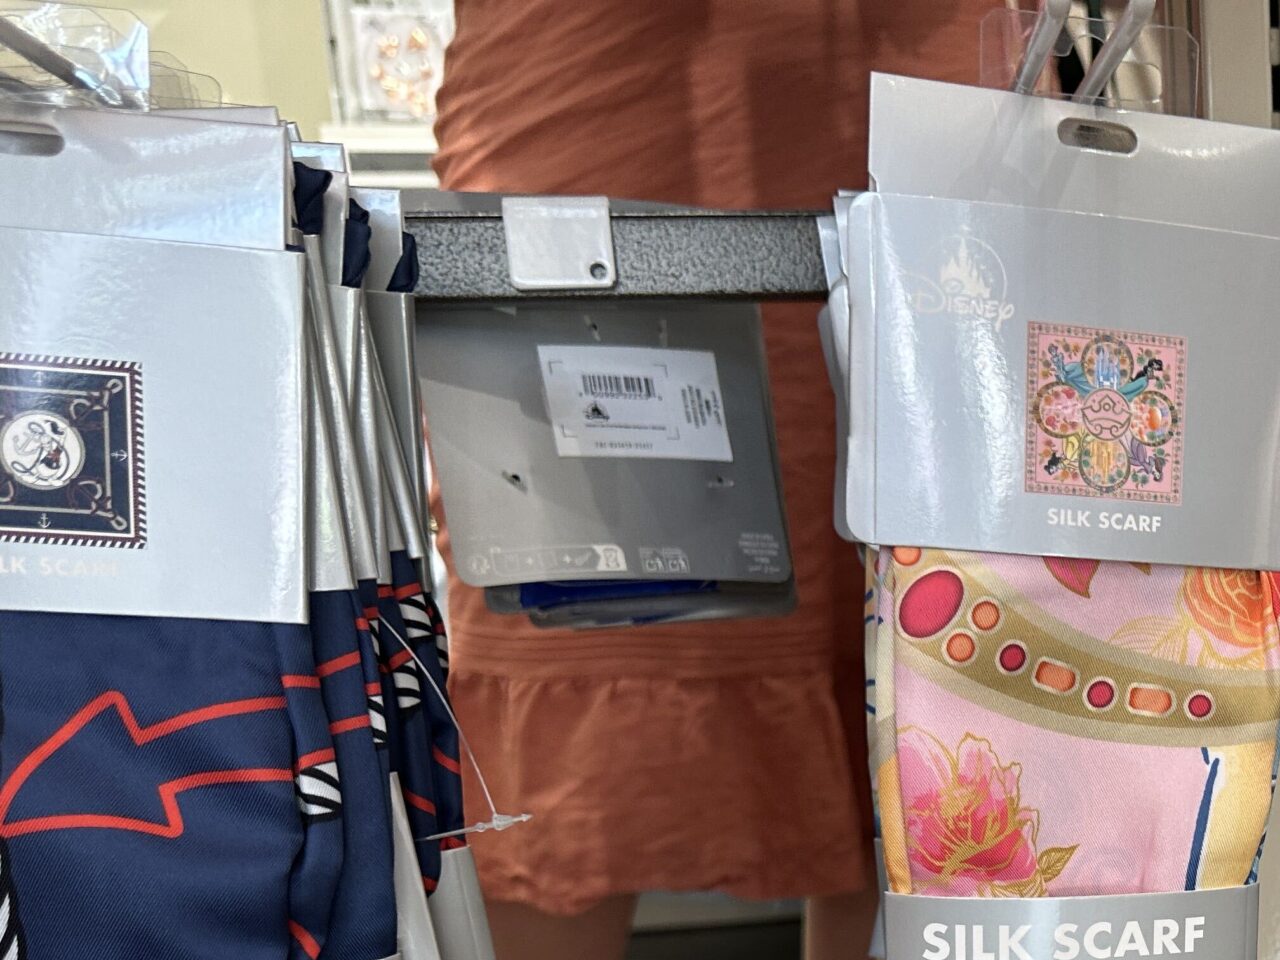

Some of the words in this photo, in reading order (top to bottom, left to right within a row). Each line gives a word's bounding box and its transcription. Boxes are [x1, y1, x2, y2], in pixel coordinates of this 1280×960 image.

[1047, 507, 1092, 528] SILK
[1098, 511, 1162, 533] SCARF
[1053, 916, 1206, 960] SCARF
